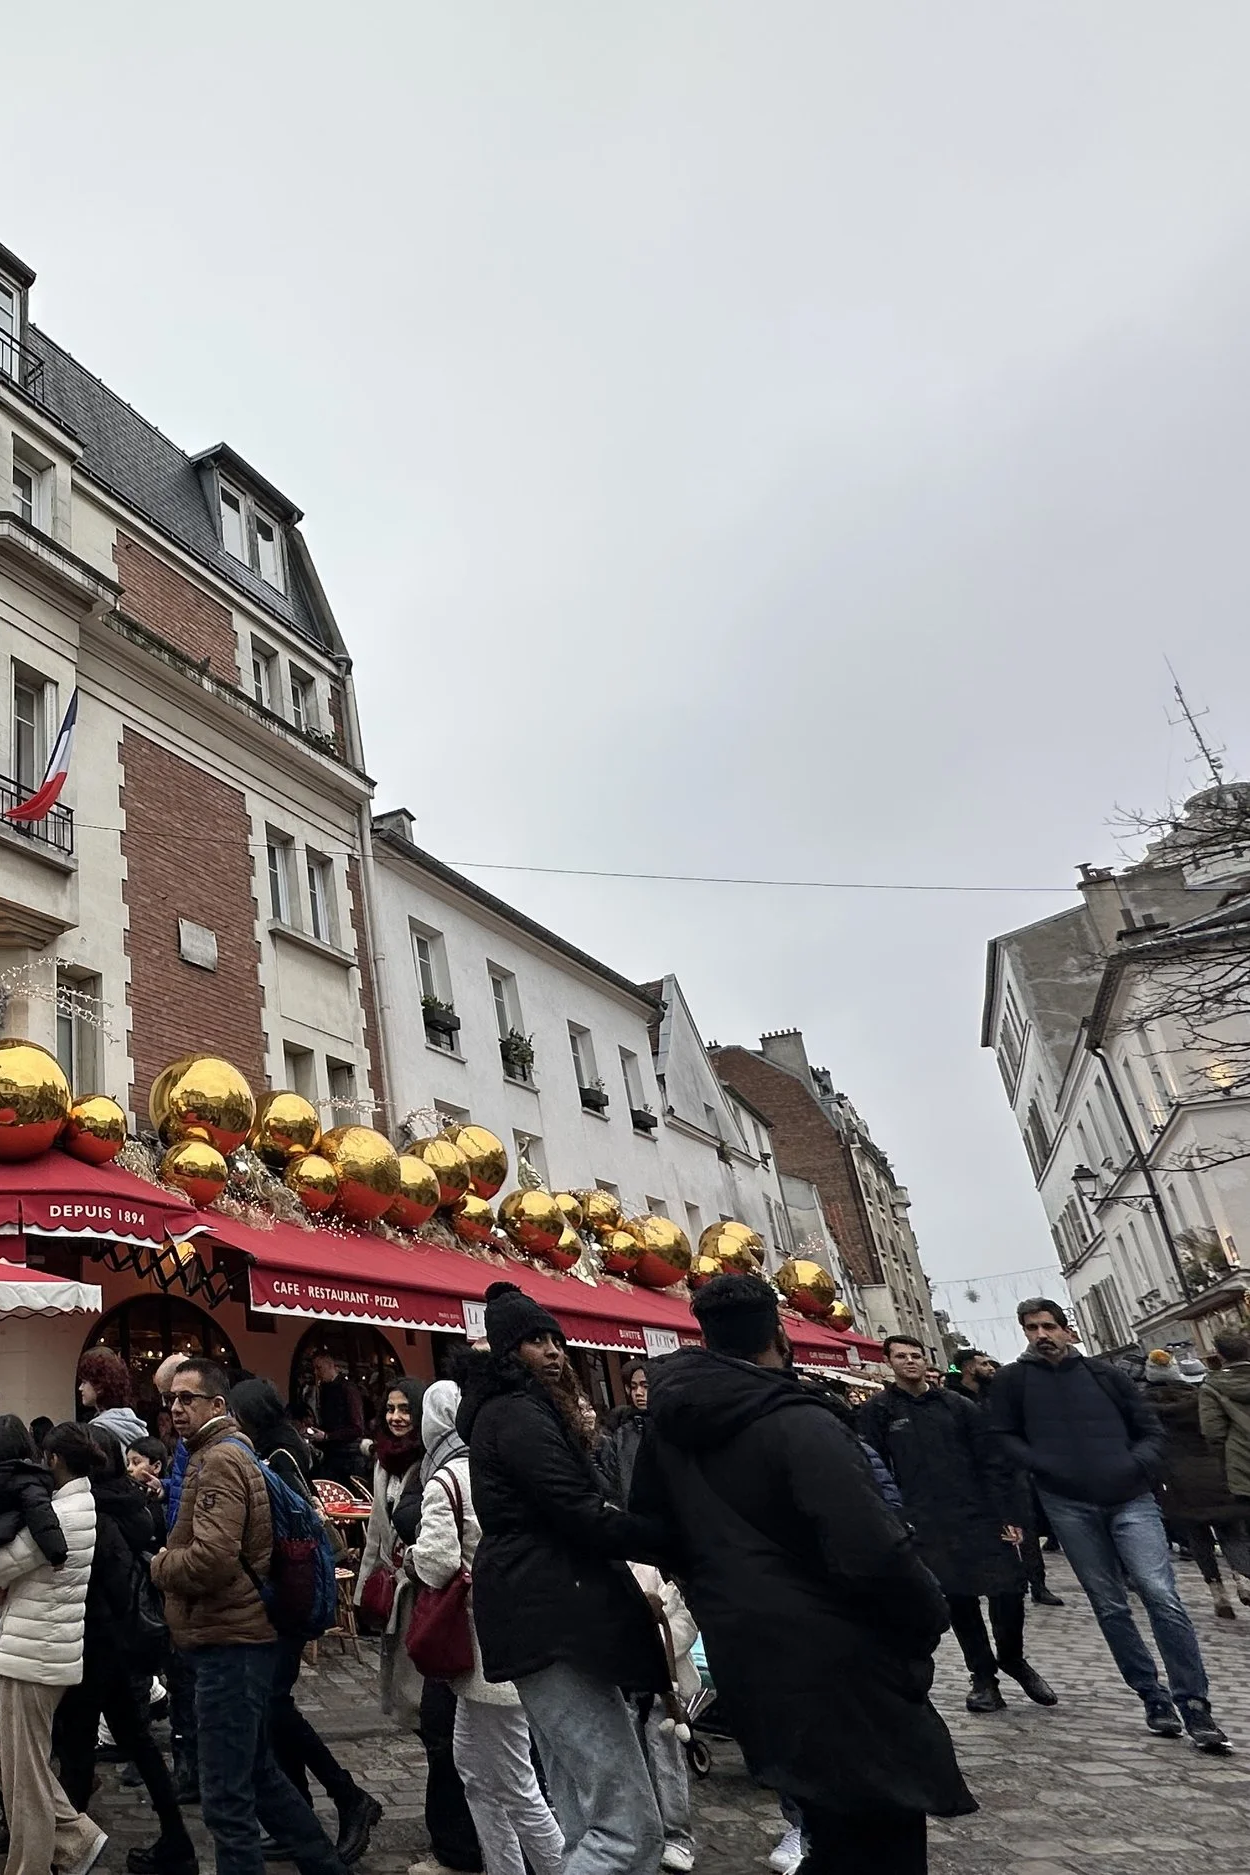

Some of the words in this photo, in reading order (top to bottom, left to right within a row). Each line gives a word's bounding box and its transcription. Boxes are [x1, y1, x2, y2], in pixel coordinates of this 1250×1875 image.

[49, 1204, 112, 1219] DEPUIS
[118, 1209, 145, 1226] 1894
[273, 1280, 300, 1296] CAFE
[308, 1285, 370, 1305] RESTAURANT
[374, 1294, 400, 1309] PIZZA
